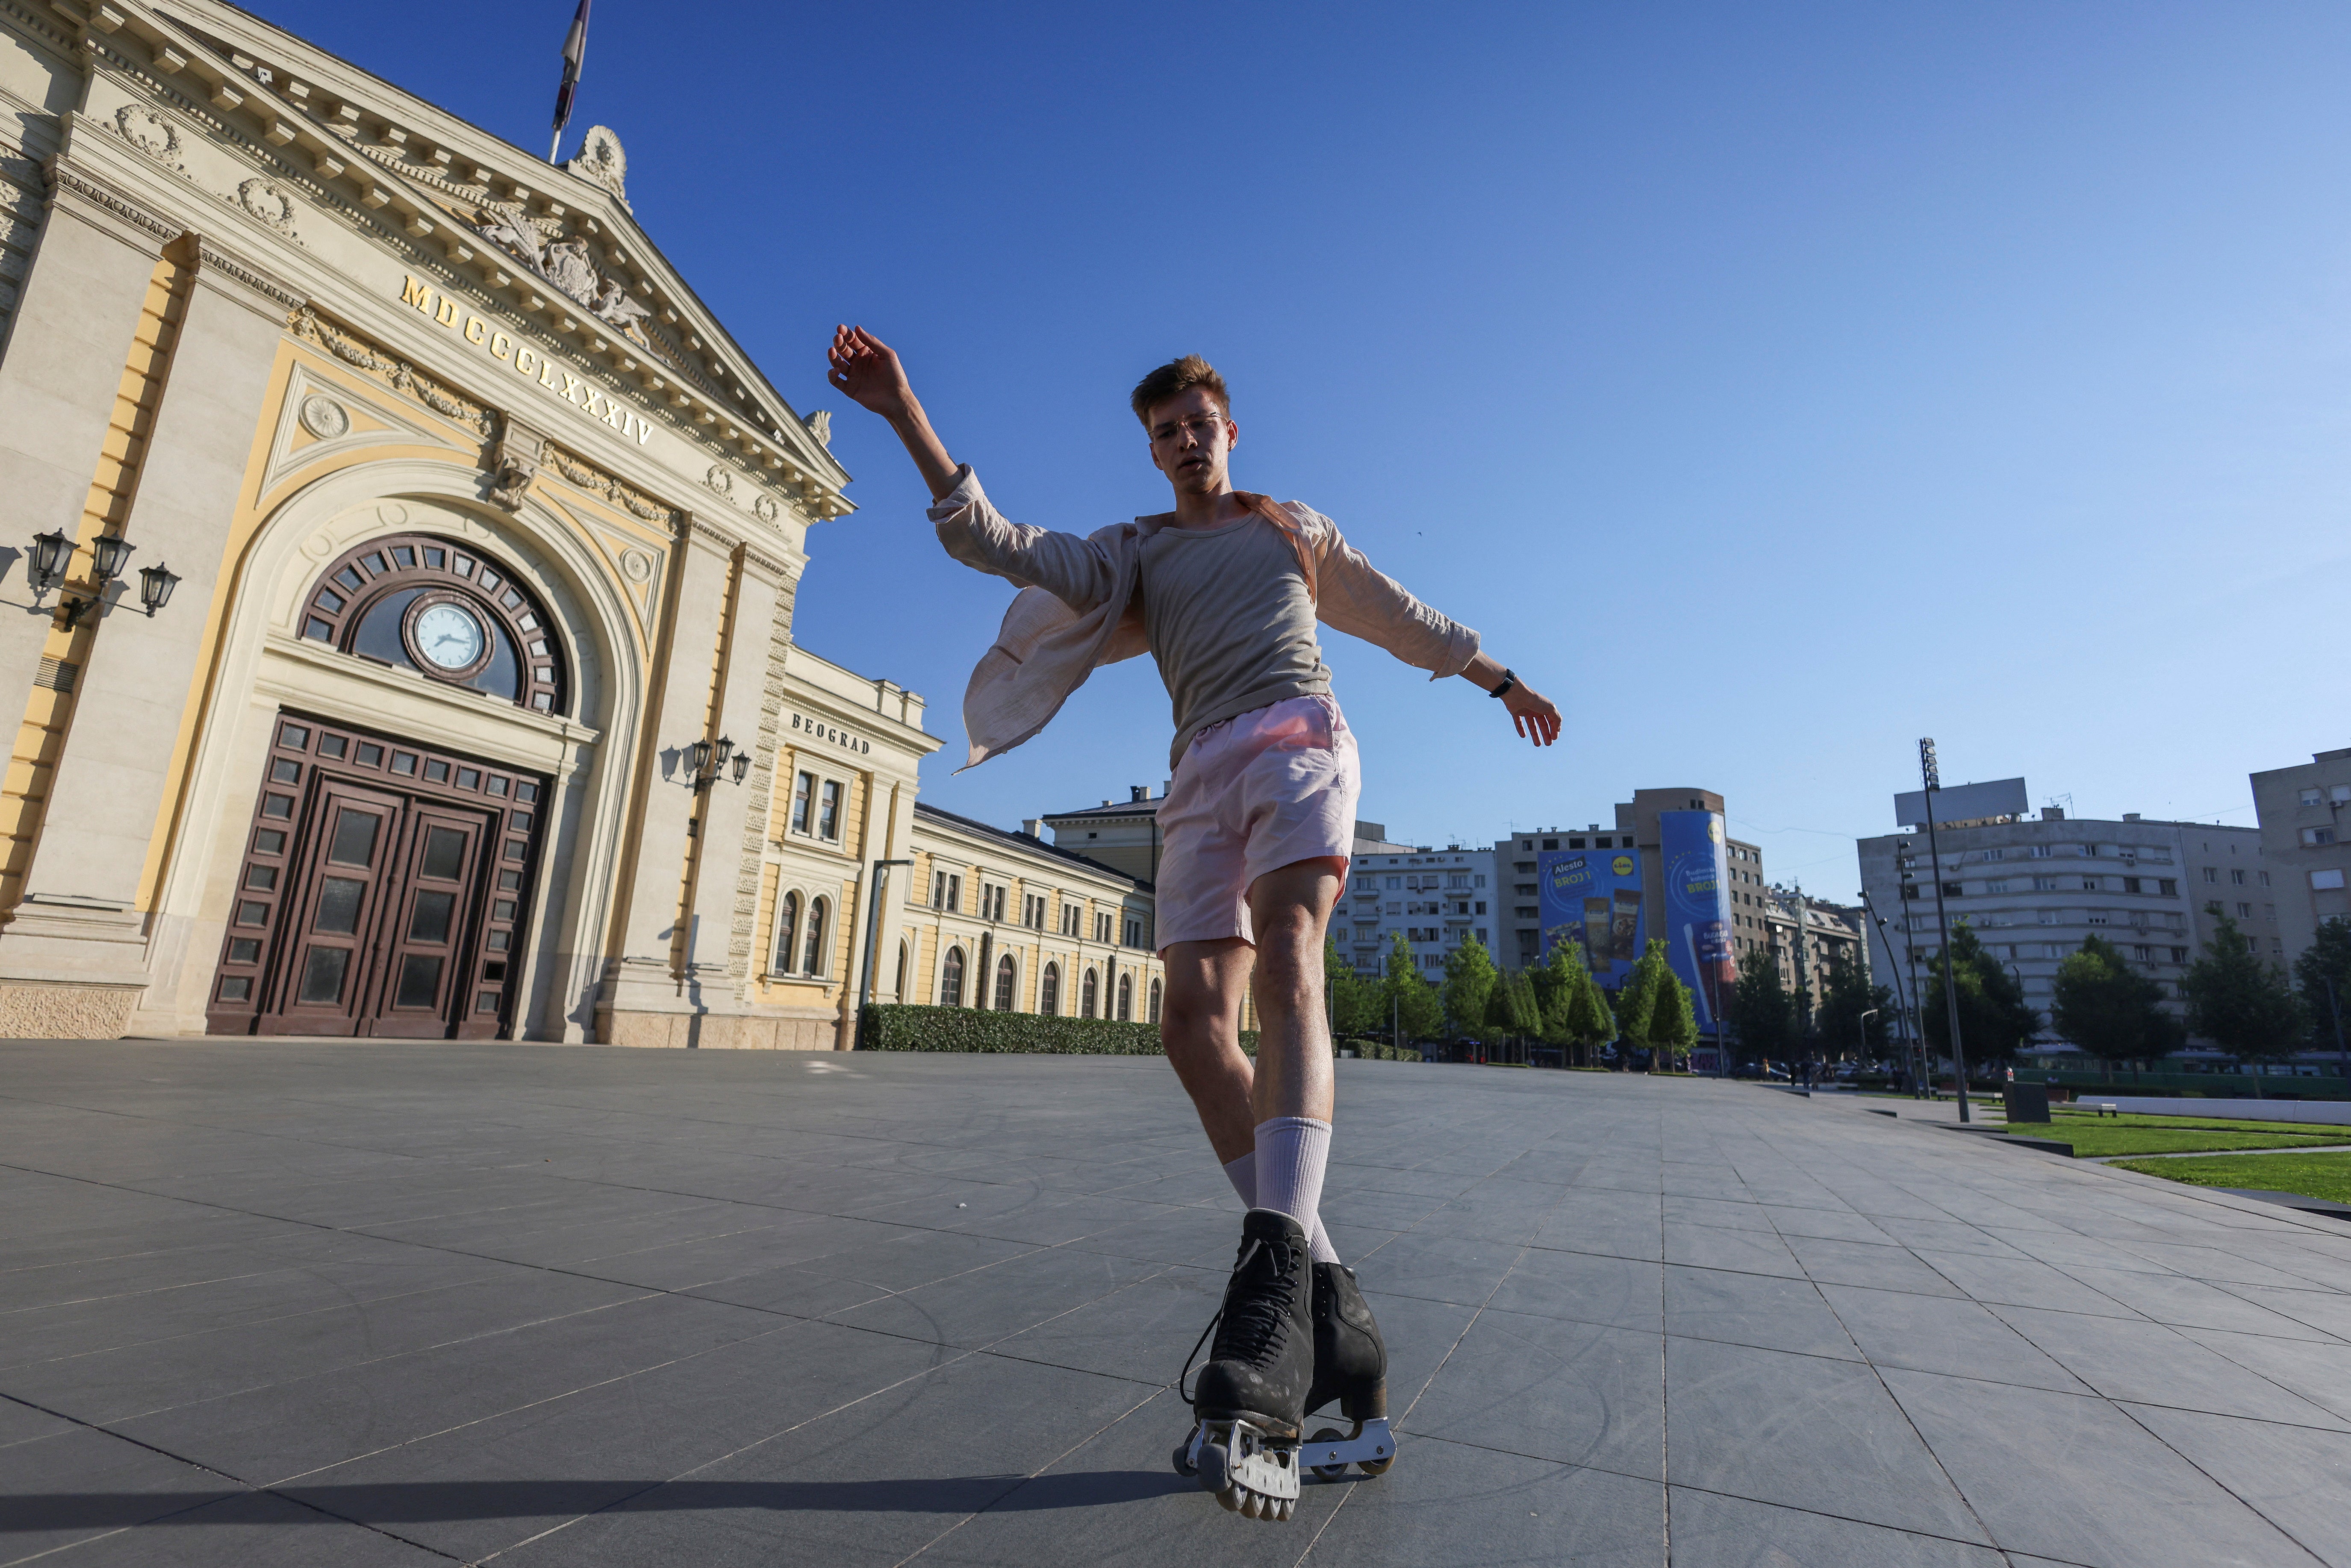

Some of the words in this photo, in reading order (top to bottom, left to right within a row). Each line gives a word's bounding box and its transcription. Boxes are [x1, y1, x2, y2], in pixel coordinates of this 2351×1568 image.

[401, 274, 654, 445] MDCCCLXXXIV
[792, 713, 869, 754] BEOGRAD
[1555, 860, 1583, 875] Alesto
[1554, 872, 1584, 888] BROJ
[1585, 870, 1591, 880] 1
[1686, 880, 1716, 893] BROJ
